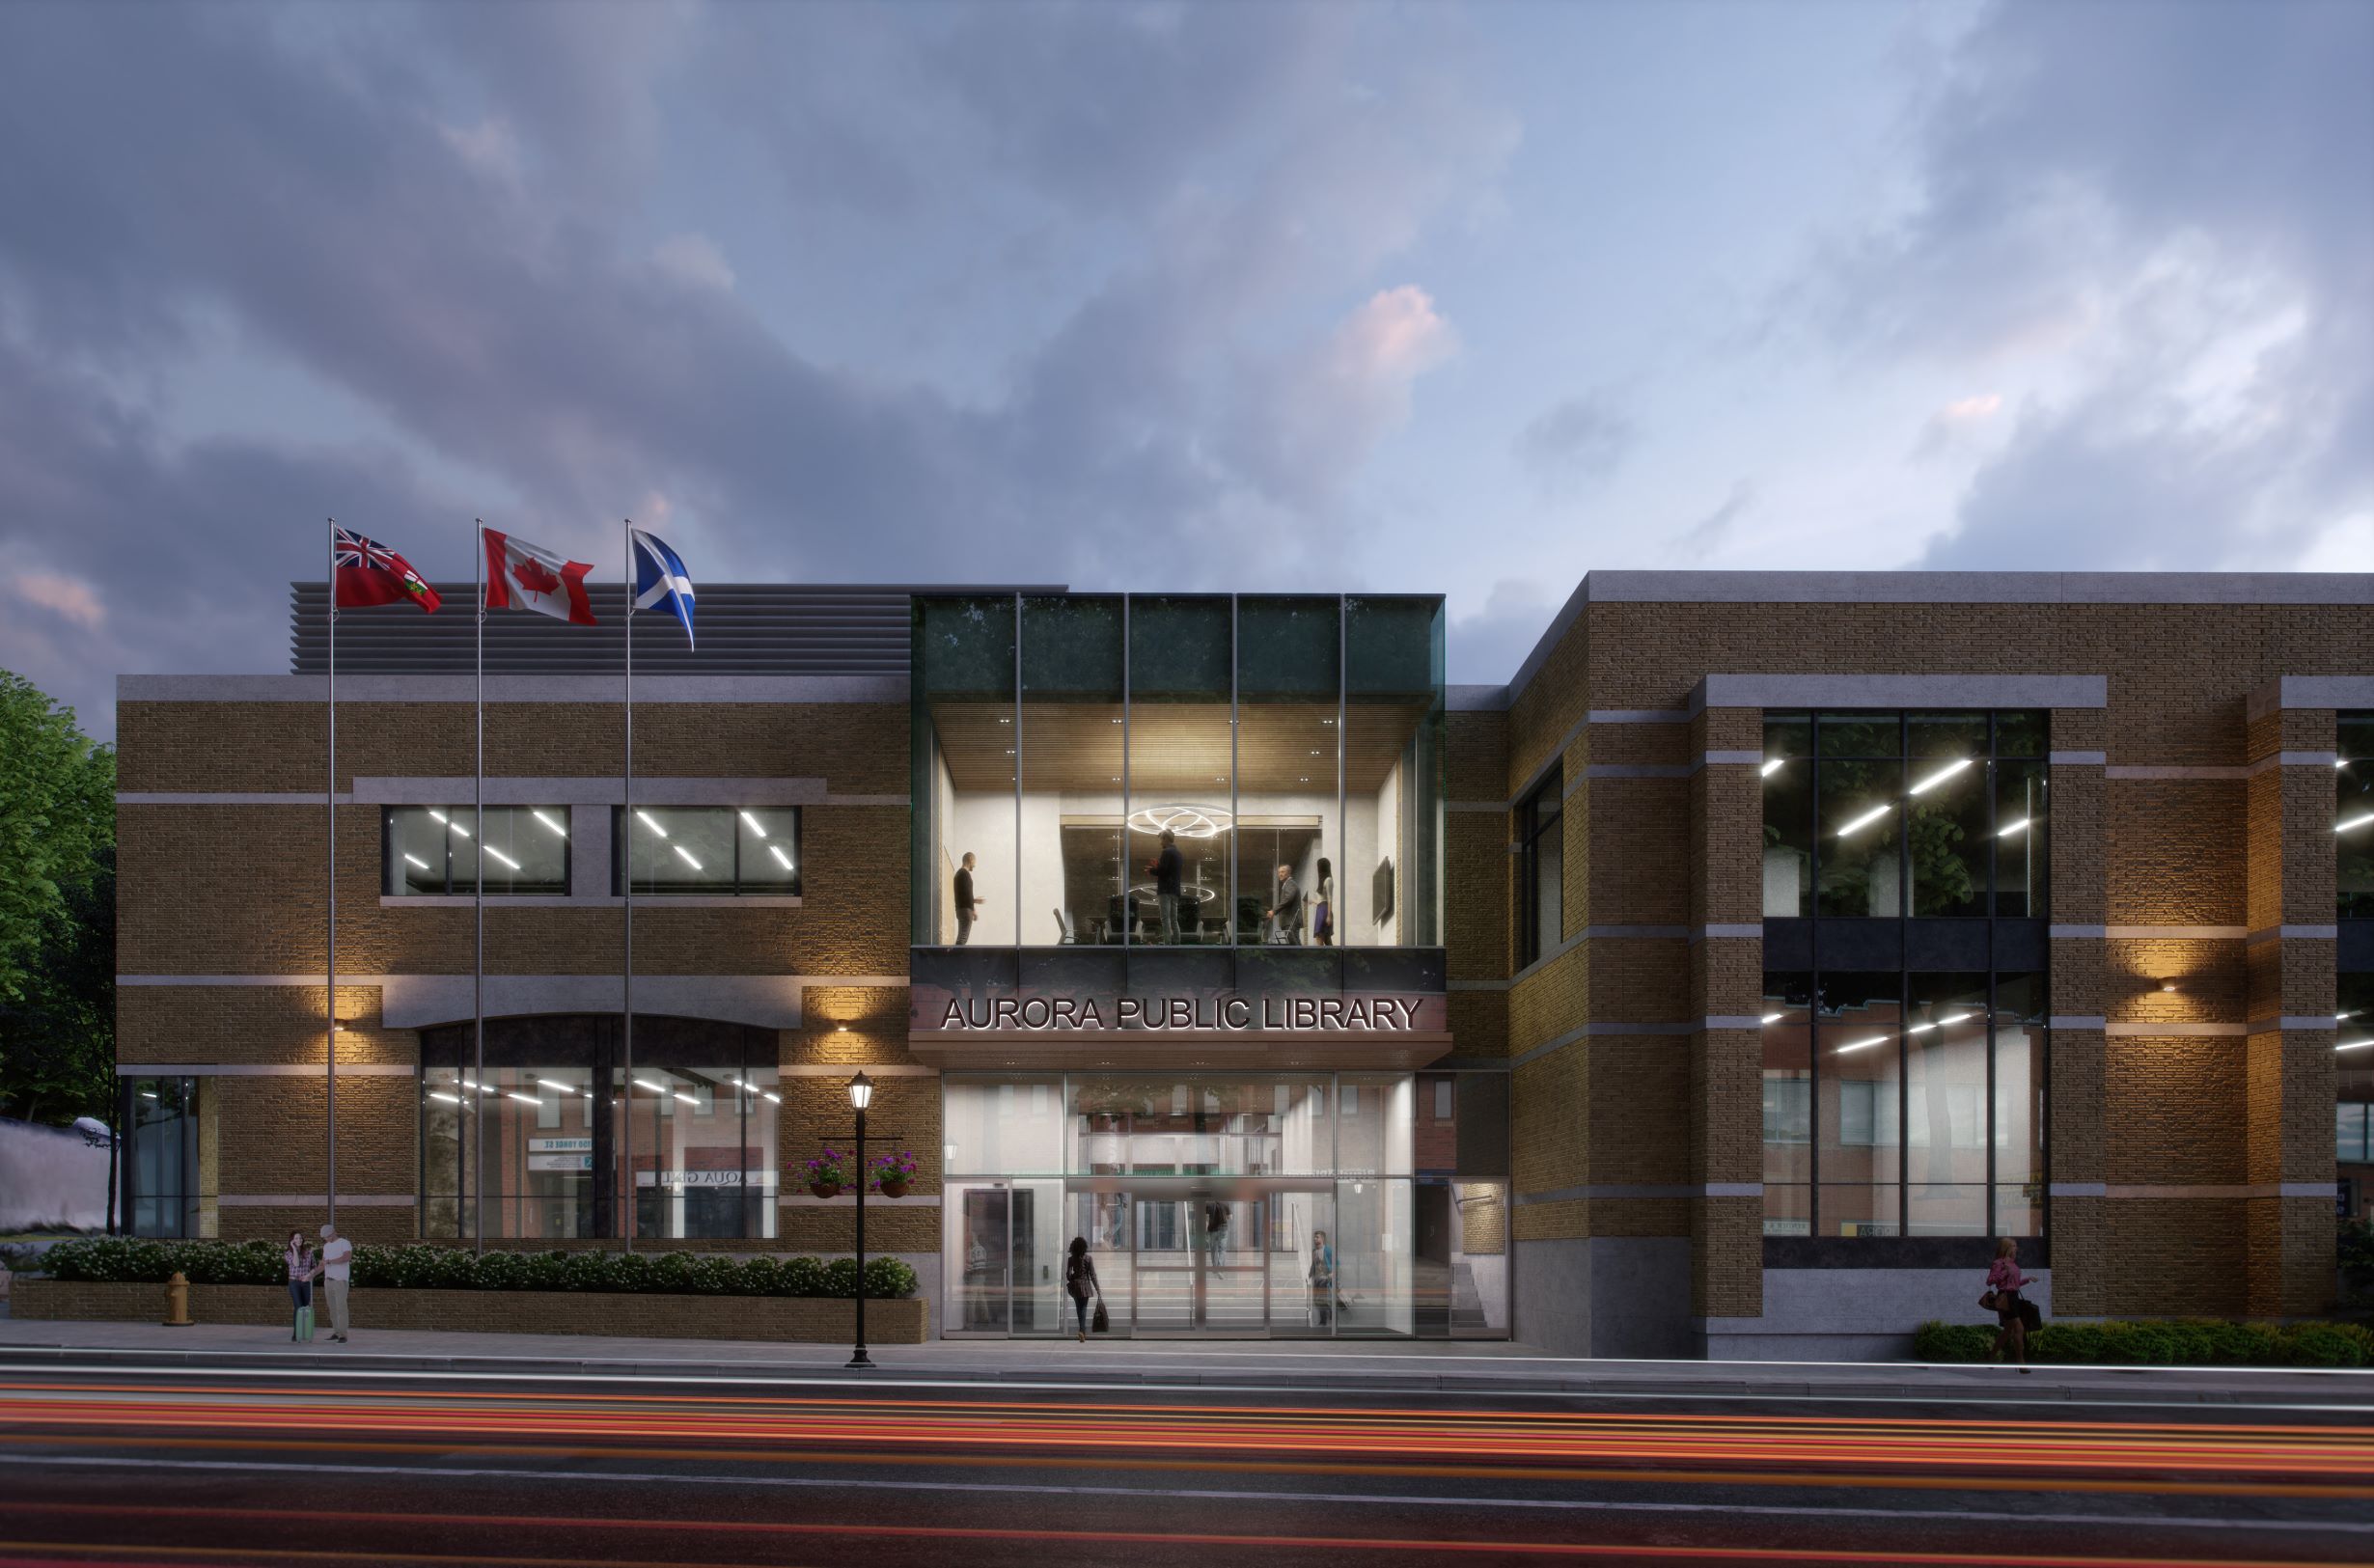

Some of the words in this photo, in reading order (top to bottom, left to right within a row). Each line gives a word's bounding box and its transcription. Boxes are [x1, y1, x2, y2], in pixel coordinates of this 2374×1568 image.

[941, 998, 1105, 1030] AURORA
[1117, 998, 1251, 1030] PUBLIC
[1262, 998, 1423, 1030] LIBRARY
